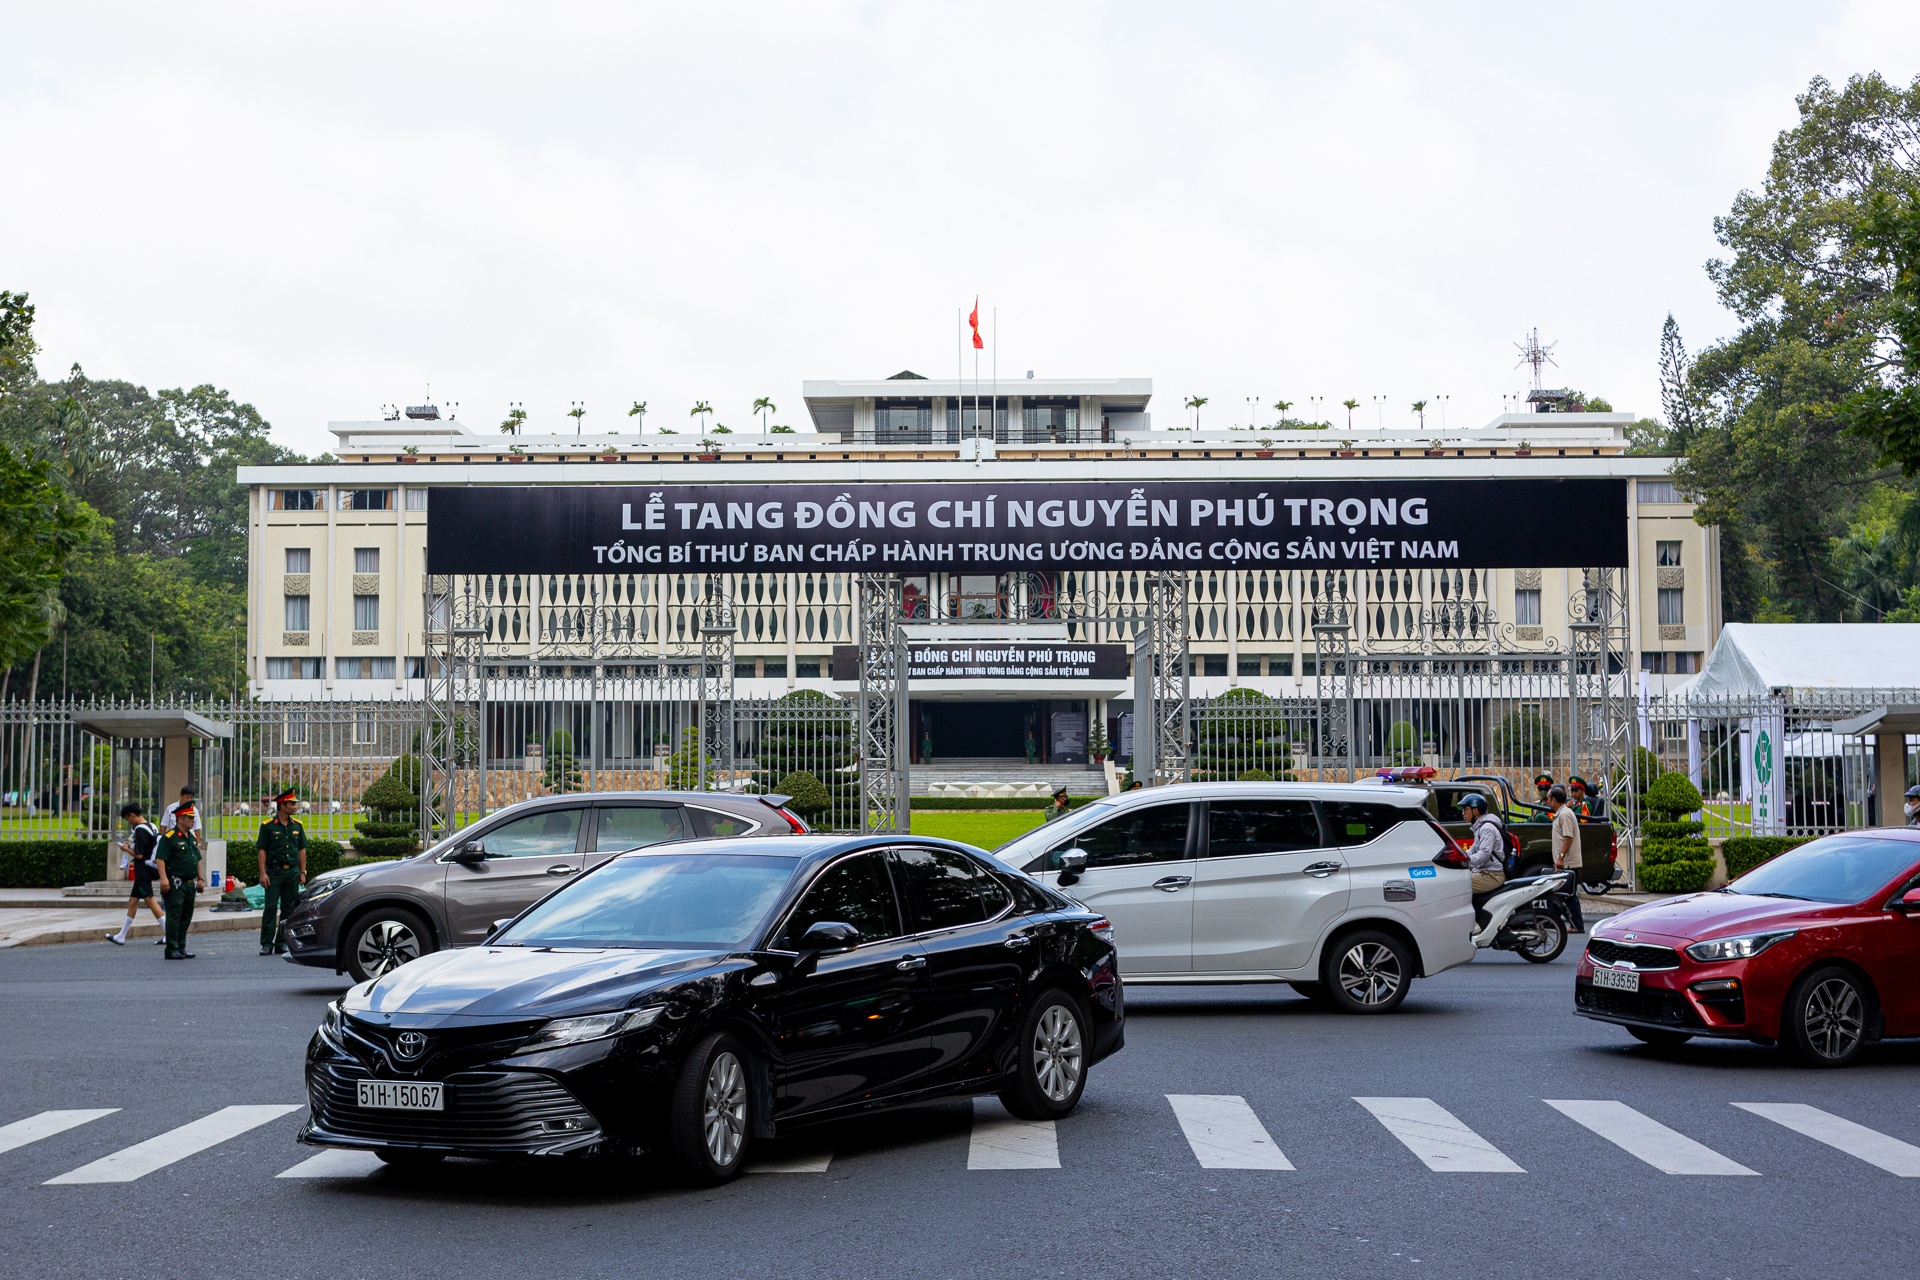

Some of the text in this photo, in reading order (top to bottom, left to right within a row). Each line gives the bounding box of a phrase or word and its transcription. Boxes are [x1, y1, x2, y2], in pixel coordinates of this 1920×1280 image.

[621, 488, 1429, 535] LỄ TANG ĐỒNG CHÍ NGUYỄN PHÚ TRỌNG
[592, 537, 1459, 564] TỔNG BÍ THƯ BAN CHẤP HÀNH TRUNG ƯƠNG ĐẢNG CỘNG SẢN VIỆT NAM
[951, 647, 973, 663] CHÍ
[975, 645, 1025, 663] NGUYỄN
[1027, 647, 1053, 663] PHÚ
[1055, 650, 1096, 666] TRỌNG
[912, 667, 926, 676] BAN
[927, 665, 945, 676] CHẤP
[945, 666, 964, 676] HÀNH
[964, 667, 986, 676] TRUNG
[1025, 666, 1044, 677] CỘNG
[1044, 665, 1059, 676] SẢN
[1059, 666, 1073, 678] VIỆT
[1074, 667, 1090, 676] NAM
[1412, 868, 1433, 877] Grab
[1594, 970, 1638, 990] 51H-335.55
[360, 1084, 440, 1108] 51H-150.67
